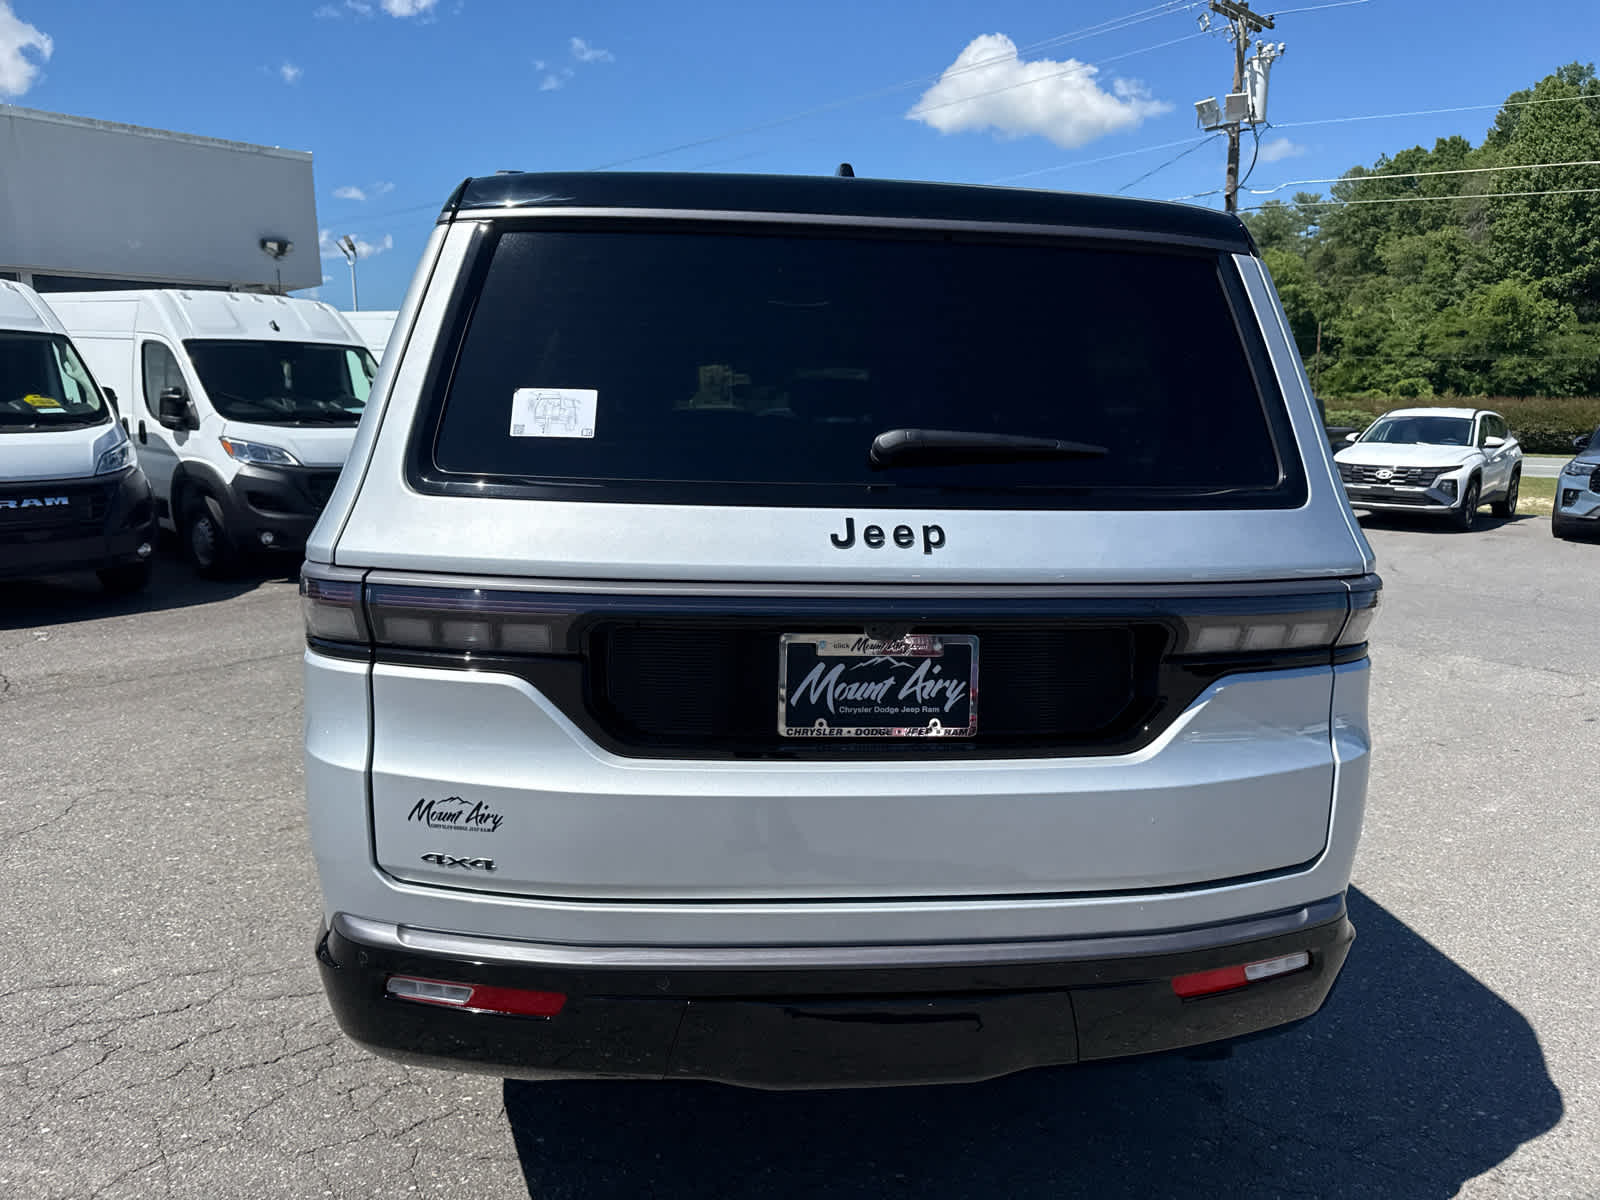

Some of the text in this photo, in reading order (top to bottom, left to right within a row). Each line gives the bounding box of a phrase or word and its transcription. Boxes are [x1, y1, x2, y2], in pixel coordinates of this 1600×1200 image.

[0, 497, 69, 509] RAM
[830, 517, 946, 554] Jeep
[790, 658, 966, 714] Mount Airy
[839, 706, 872, 714] Chrysler
[874, 706, 900, 714] Dodge
[901, 706, 920, 714] Jeep
[786, 728, 843, 736] CHRYSLER
[855, 728, 892, 736] DODGE
[943, 728, 969, 736] RAM
[408, 798, 503, 832] Mount Airy
